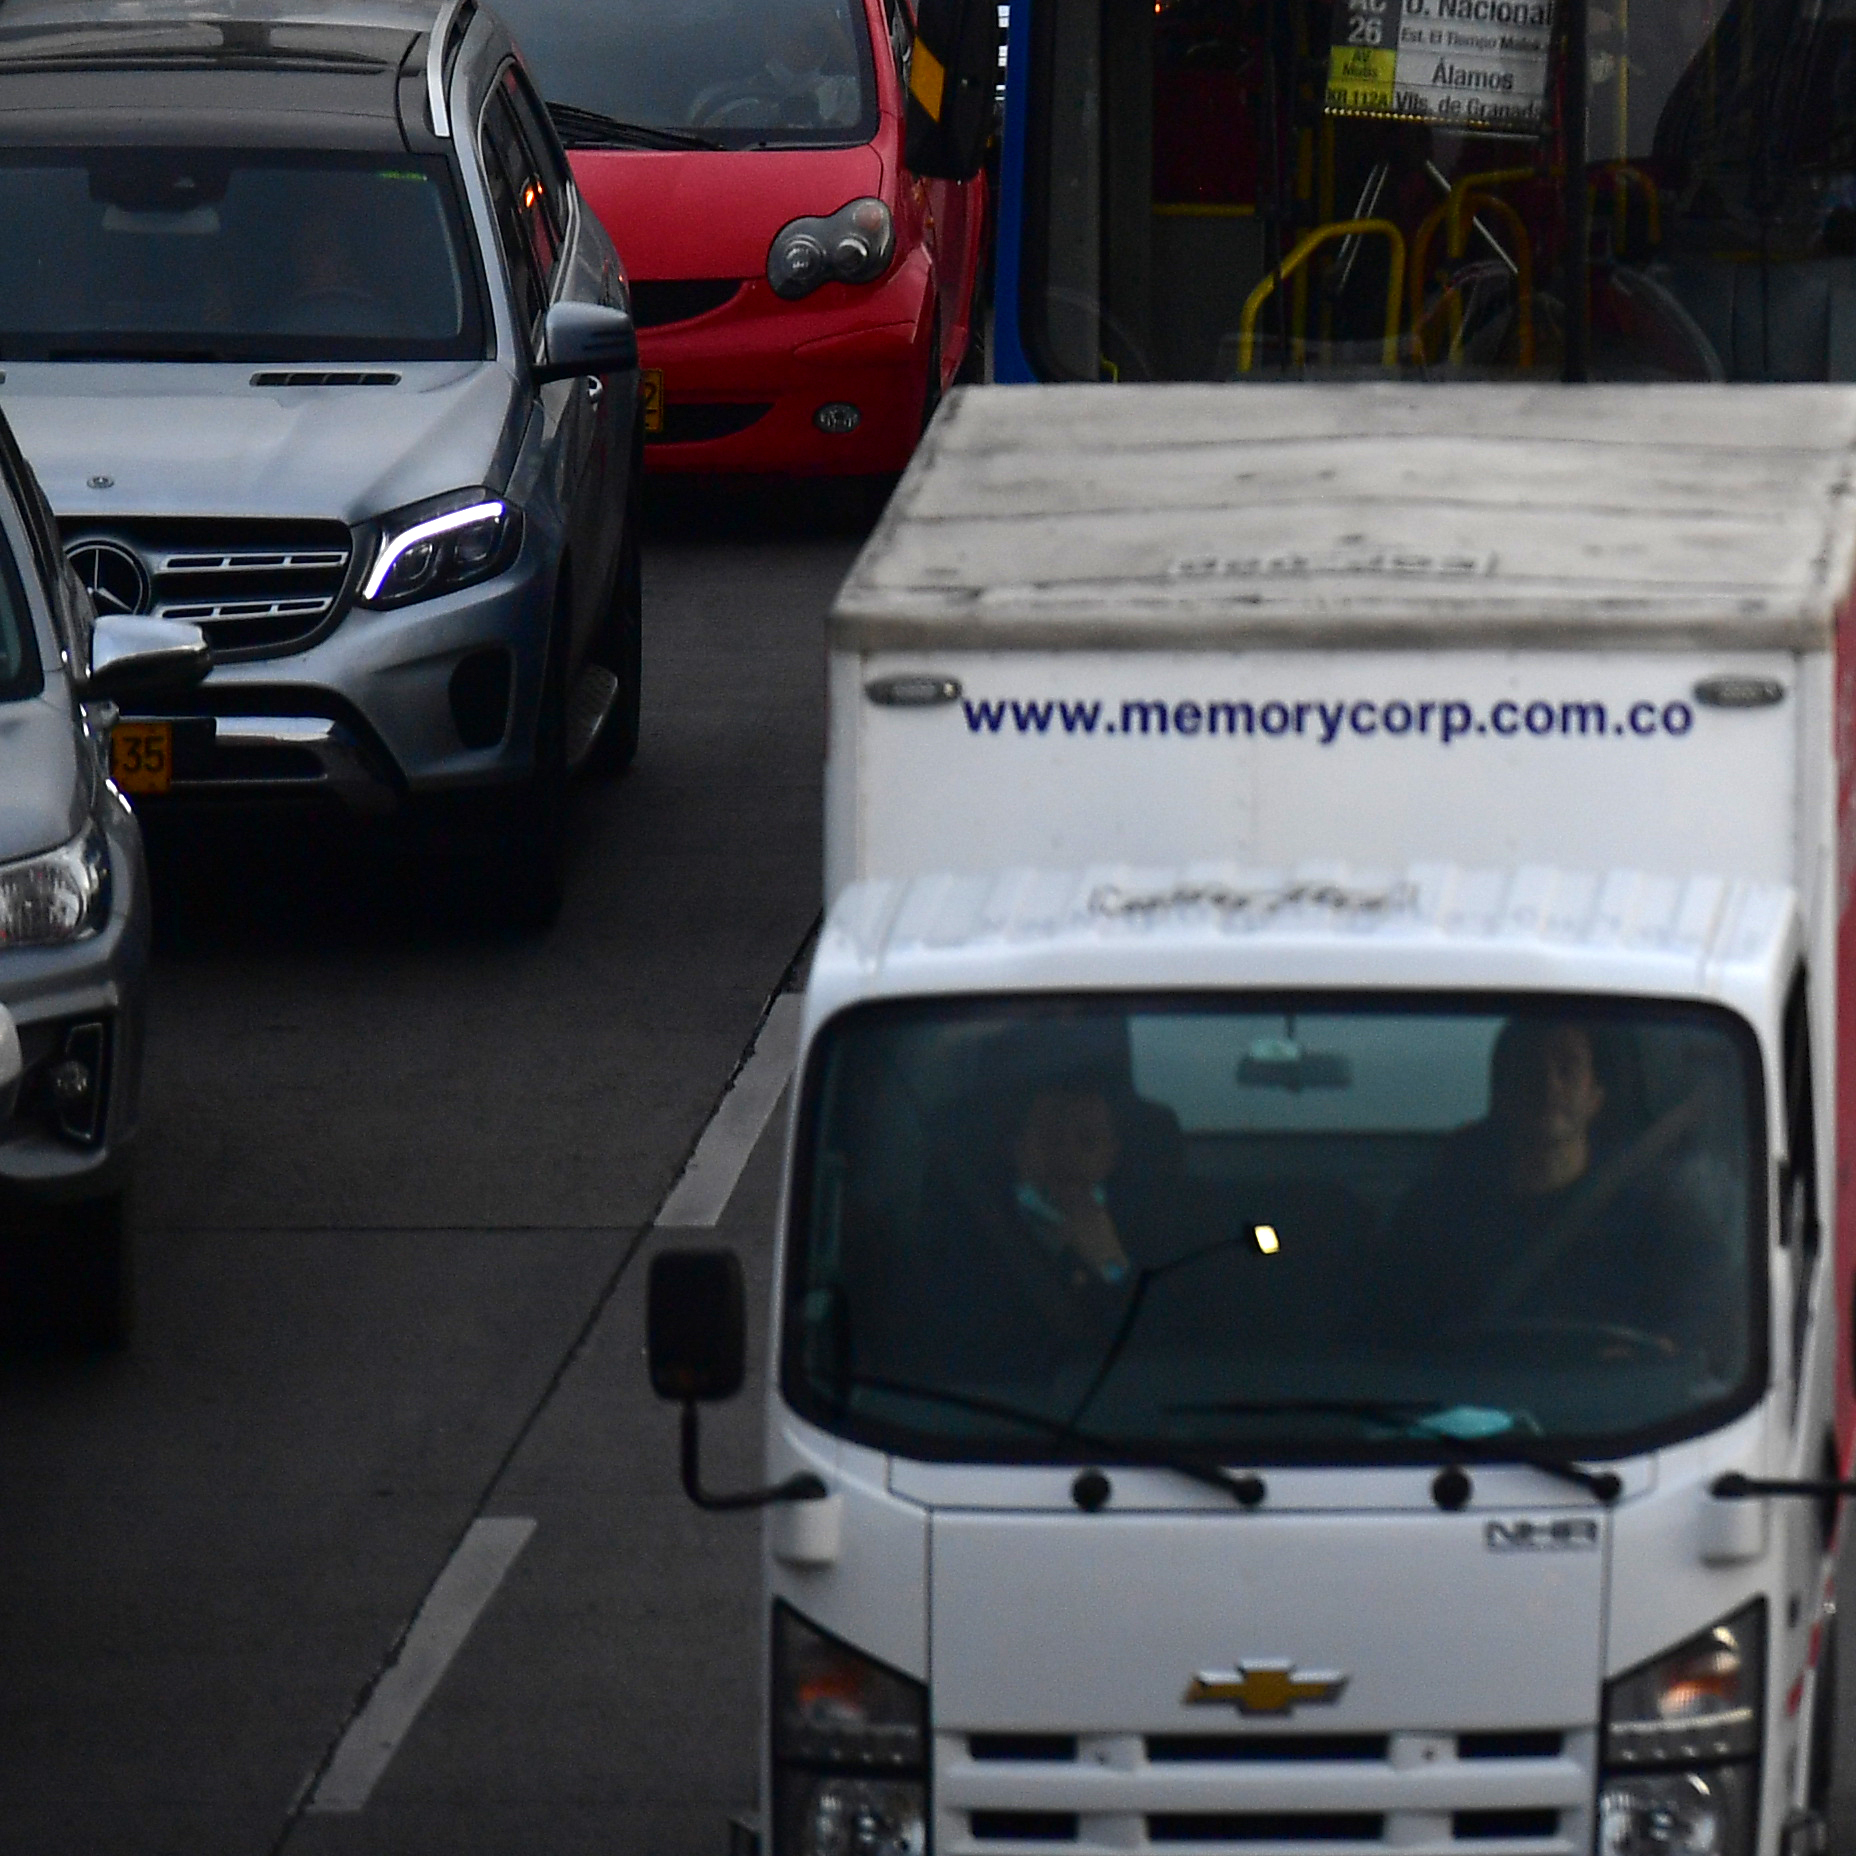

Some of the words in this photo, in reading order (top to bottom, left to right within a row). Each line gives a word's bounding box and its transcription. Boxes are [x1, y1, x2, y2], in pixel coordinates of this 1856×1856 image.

[1348, 16, 1383, 45] 26
[1432, 56, 1515, 91] Álamos
[1438, 96, 1462, 114] de
[962, 696, 1693, 744] www.memorycorp.com.co
